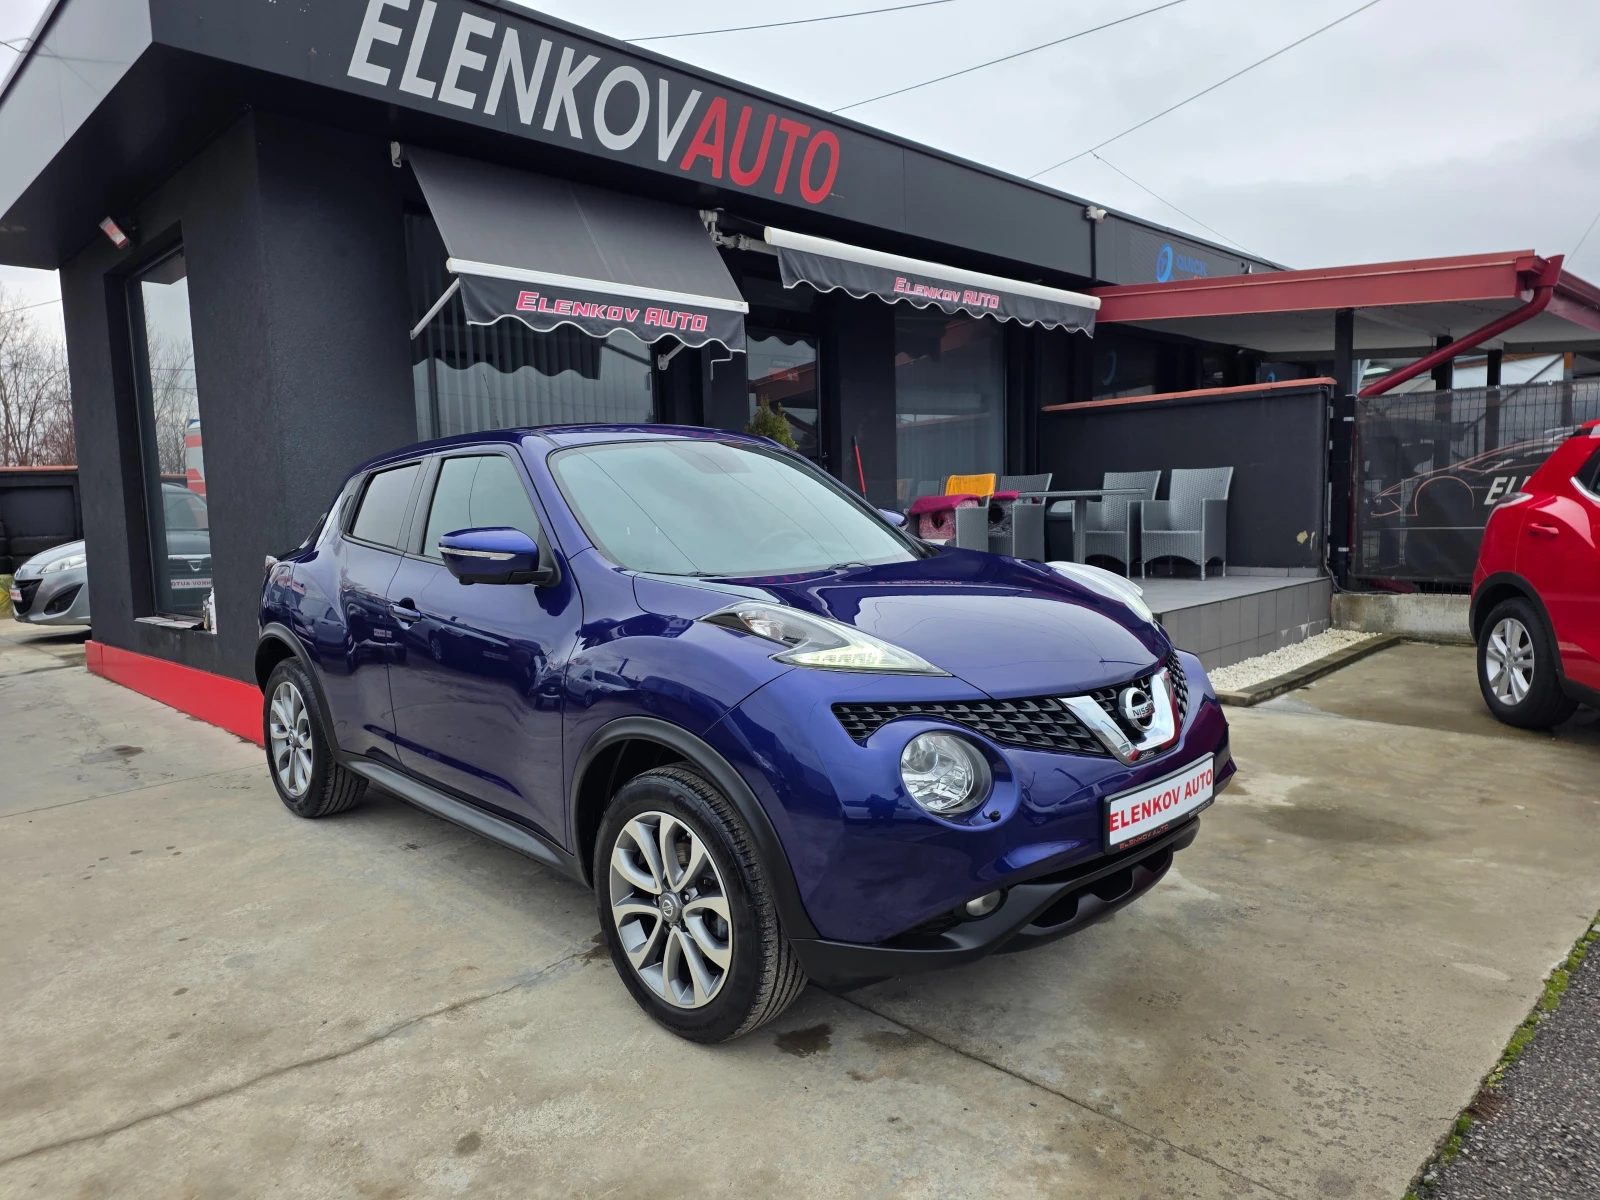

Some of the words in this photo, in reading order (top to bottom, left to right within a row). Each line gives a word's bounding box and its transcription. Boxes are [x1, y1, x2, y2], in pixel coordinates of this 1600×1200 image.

[516, 291, 640, 322] ELENKOV
[644, 307, 707, 332] AUTO
[893, 277, 961, 302] ELENKOV
[963, 289, 999, 309] AUTO
[1109, 786, 1180, 832] ELENKOV
[1184, 769, 1213, 800] AUTO
